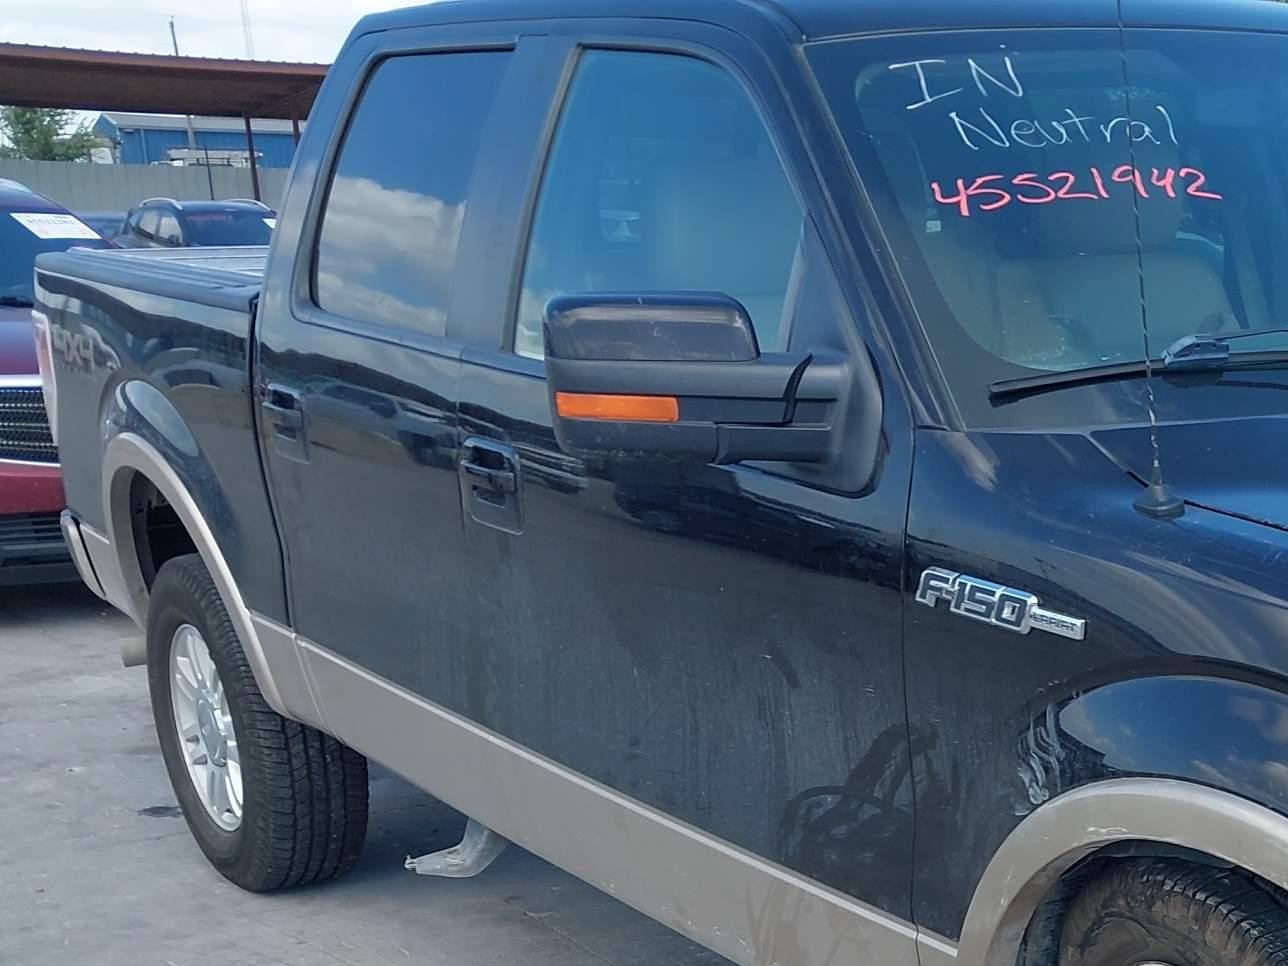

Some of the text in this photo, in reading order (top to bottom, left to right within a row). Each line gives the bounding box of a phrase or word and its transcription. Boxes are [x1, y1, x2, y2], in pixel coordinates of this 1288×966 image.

[888, 56, 1024, 110] IN
[948, 106, 1180, 151] Neutral
[930, 164, 1224, 217] 45521942
[915, 566, 1039, 635] F-150
